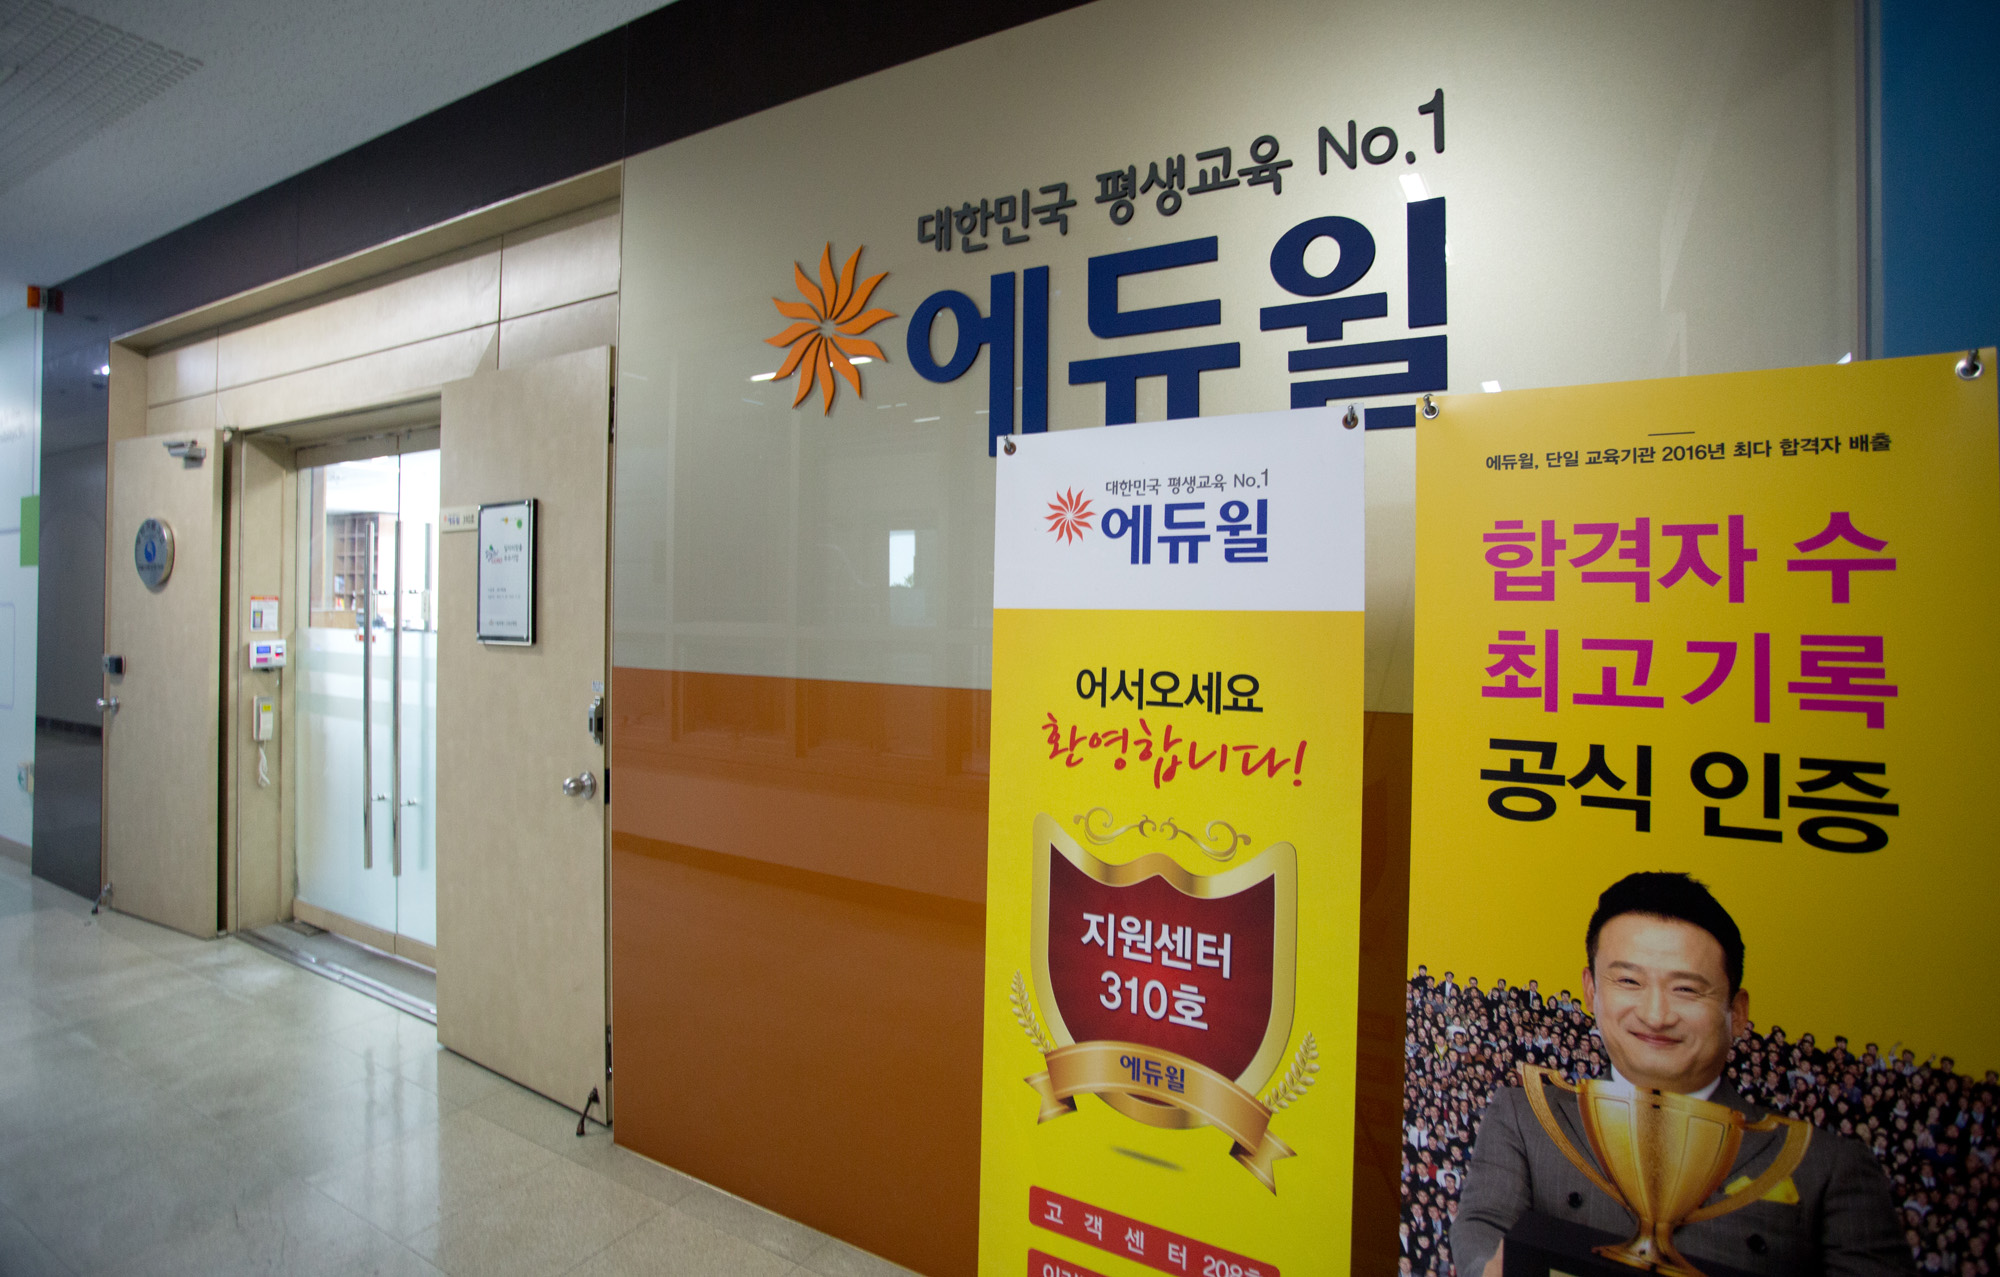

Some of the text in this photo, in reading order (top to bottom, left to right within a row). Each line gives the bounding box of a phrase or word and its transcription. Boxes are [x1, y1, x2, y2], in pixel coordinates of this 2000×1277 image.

[918, 88, 1444, 254] 대한민국 평생교육 No.1
[906, 196, 1448, 457] 에듀윌
[1106, 469, 1268, 496] 대한민국 평생교육 No.1
[1486, 433, 1891, 470] 에듀윌, 단일 교육기관 2016년 최다 합격자 배출
[1101, 499, 1268, 565] 에듀윌
[1482, 511, 1897, 604] 합격자 수
[1076, 667, 1264, 715] 어서오세요
[1042, 713, 1307, 788] 환영합니다!
[1480, 738, 1900, 854] 공식 인증
[1080, 912, 1232, 979] 지원센터
[1099, 970, 1209, 1031] 310호
[1119, 1054, 1185, 1094] 에듀윌
